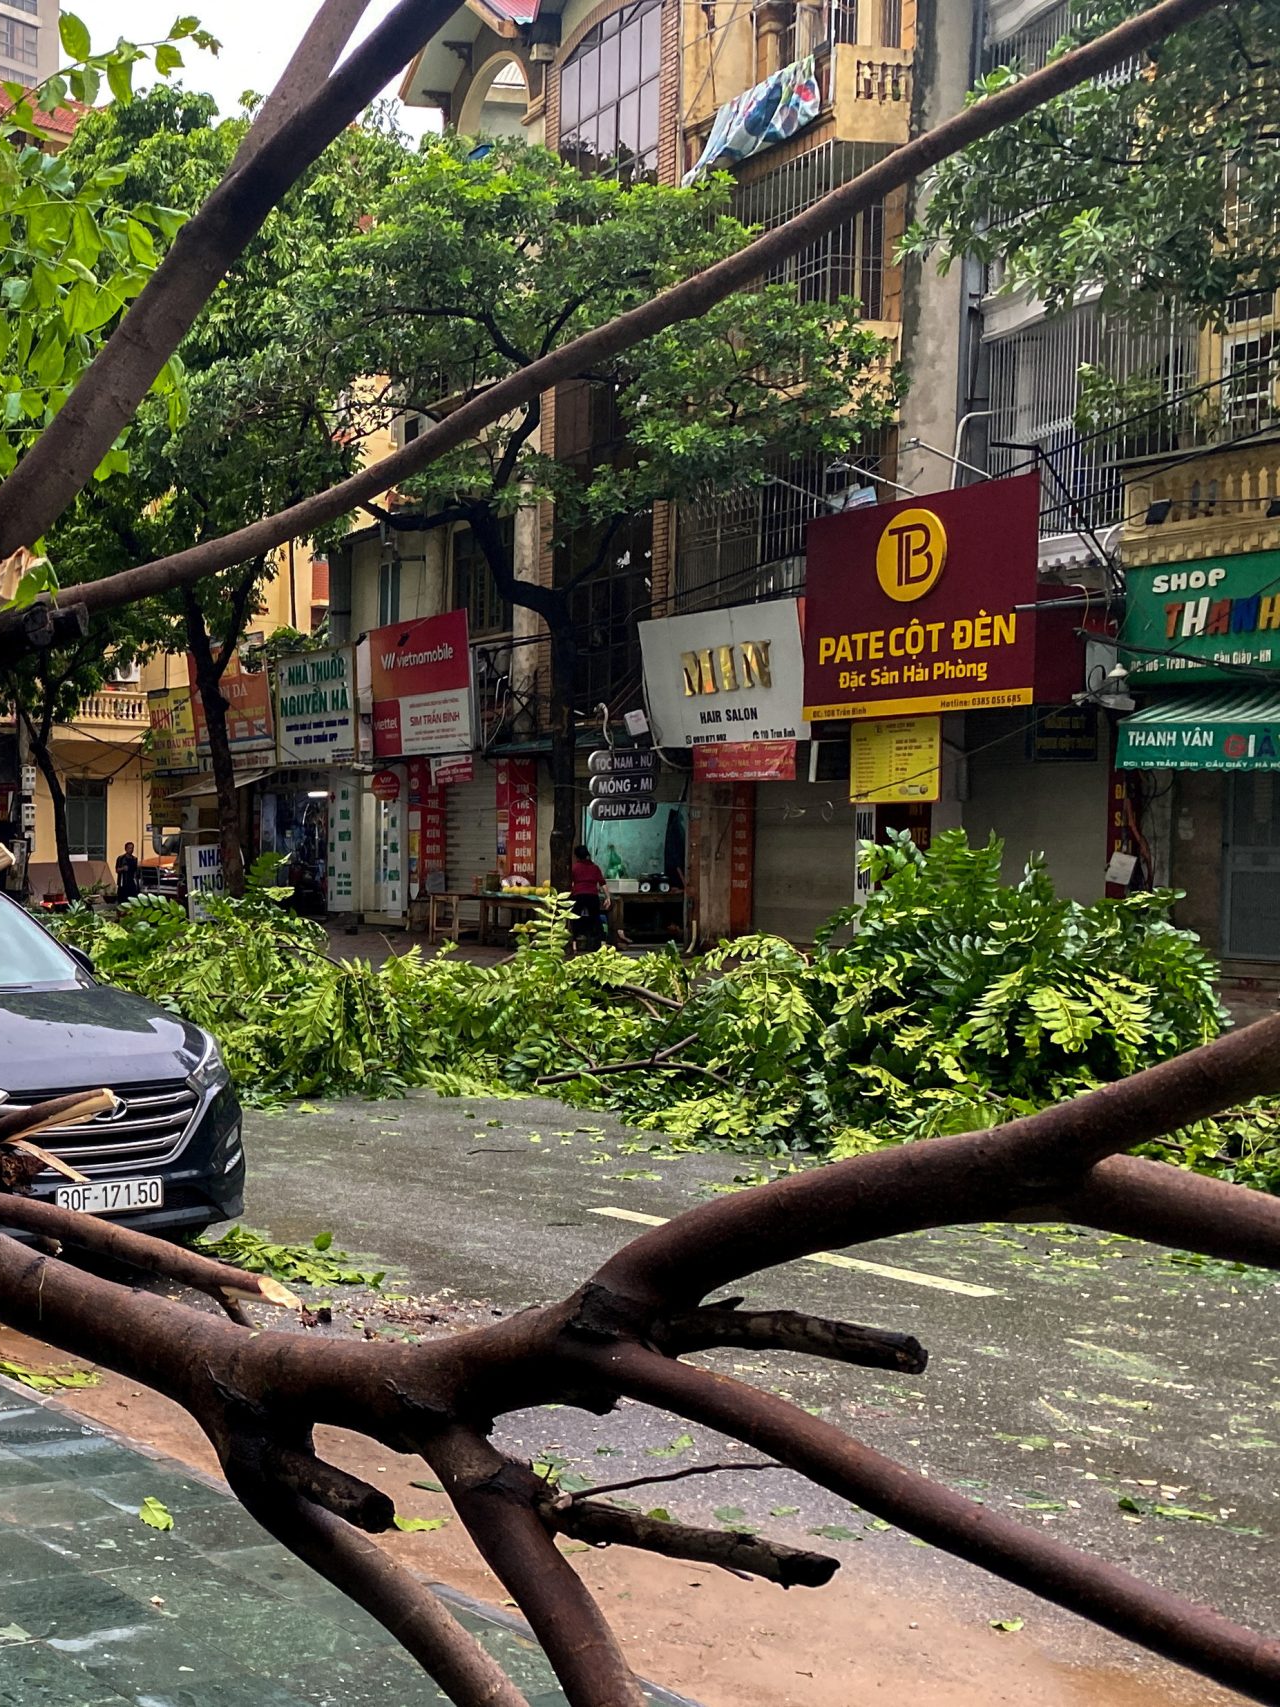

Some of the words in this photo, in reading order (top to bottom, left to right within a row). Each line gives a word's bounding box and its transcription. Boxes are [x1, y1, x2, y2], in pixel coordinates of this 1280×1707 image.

[1152, 568, 1226, 593] SHOP
[819, 630, 885, 665] PATE
[889, 618, 945, 659] CỘT
[951, 609, 1016, 650] ĐÈN
[396, 643, 453, 668] vietnamobile
[288, 658, 311, 686] NHÀ
[311, 649, 346, 682] THUỐC
[681, 639, 772, 697] MIN
[839, 671, 866, 692] Đặc
[870, 666, 899, 687] Sản
[903, 662, 929, 683] Hải
[933, 658, 988, 682] Phòng
[331, 682, 349, 711] HÀ
[940, 700, 970, 709] Hotline:
[971, 697, 990, 706] 0385
[991, 695, 1005, 704] 055
[374, 717, 398, 730] viettel
[409, 715, 422, 727] SIM
[700, 710, 722, 724] HAIR
[725, 707, 758, 722] SALON
[1128, 731, 1177, 746] THANH
[1182, 727, 1214, 746] VÂN
[1224, 727, 1280, 758] GIÀ
[614, 756, 633, 769] NAM
[516, 784, 529, 793] SIM
[598, 777, 632, 794] MÓNG
[640, 777, 653, 790] MI
[598, 803, 626, 817] PHUN
[515, 830, 531, 842] KIỆN
[515, 846, 531, 858] ĐIỆN
[60, 1181, 159, 1211] 30F-171.50
